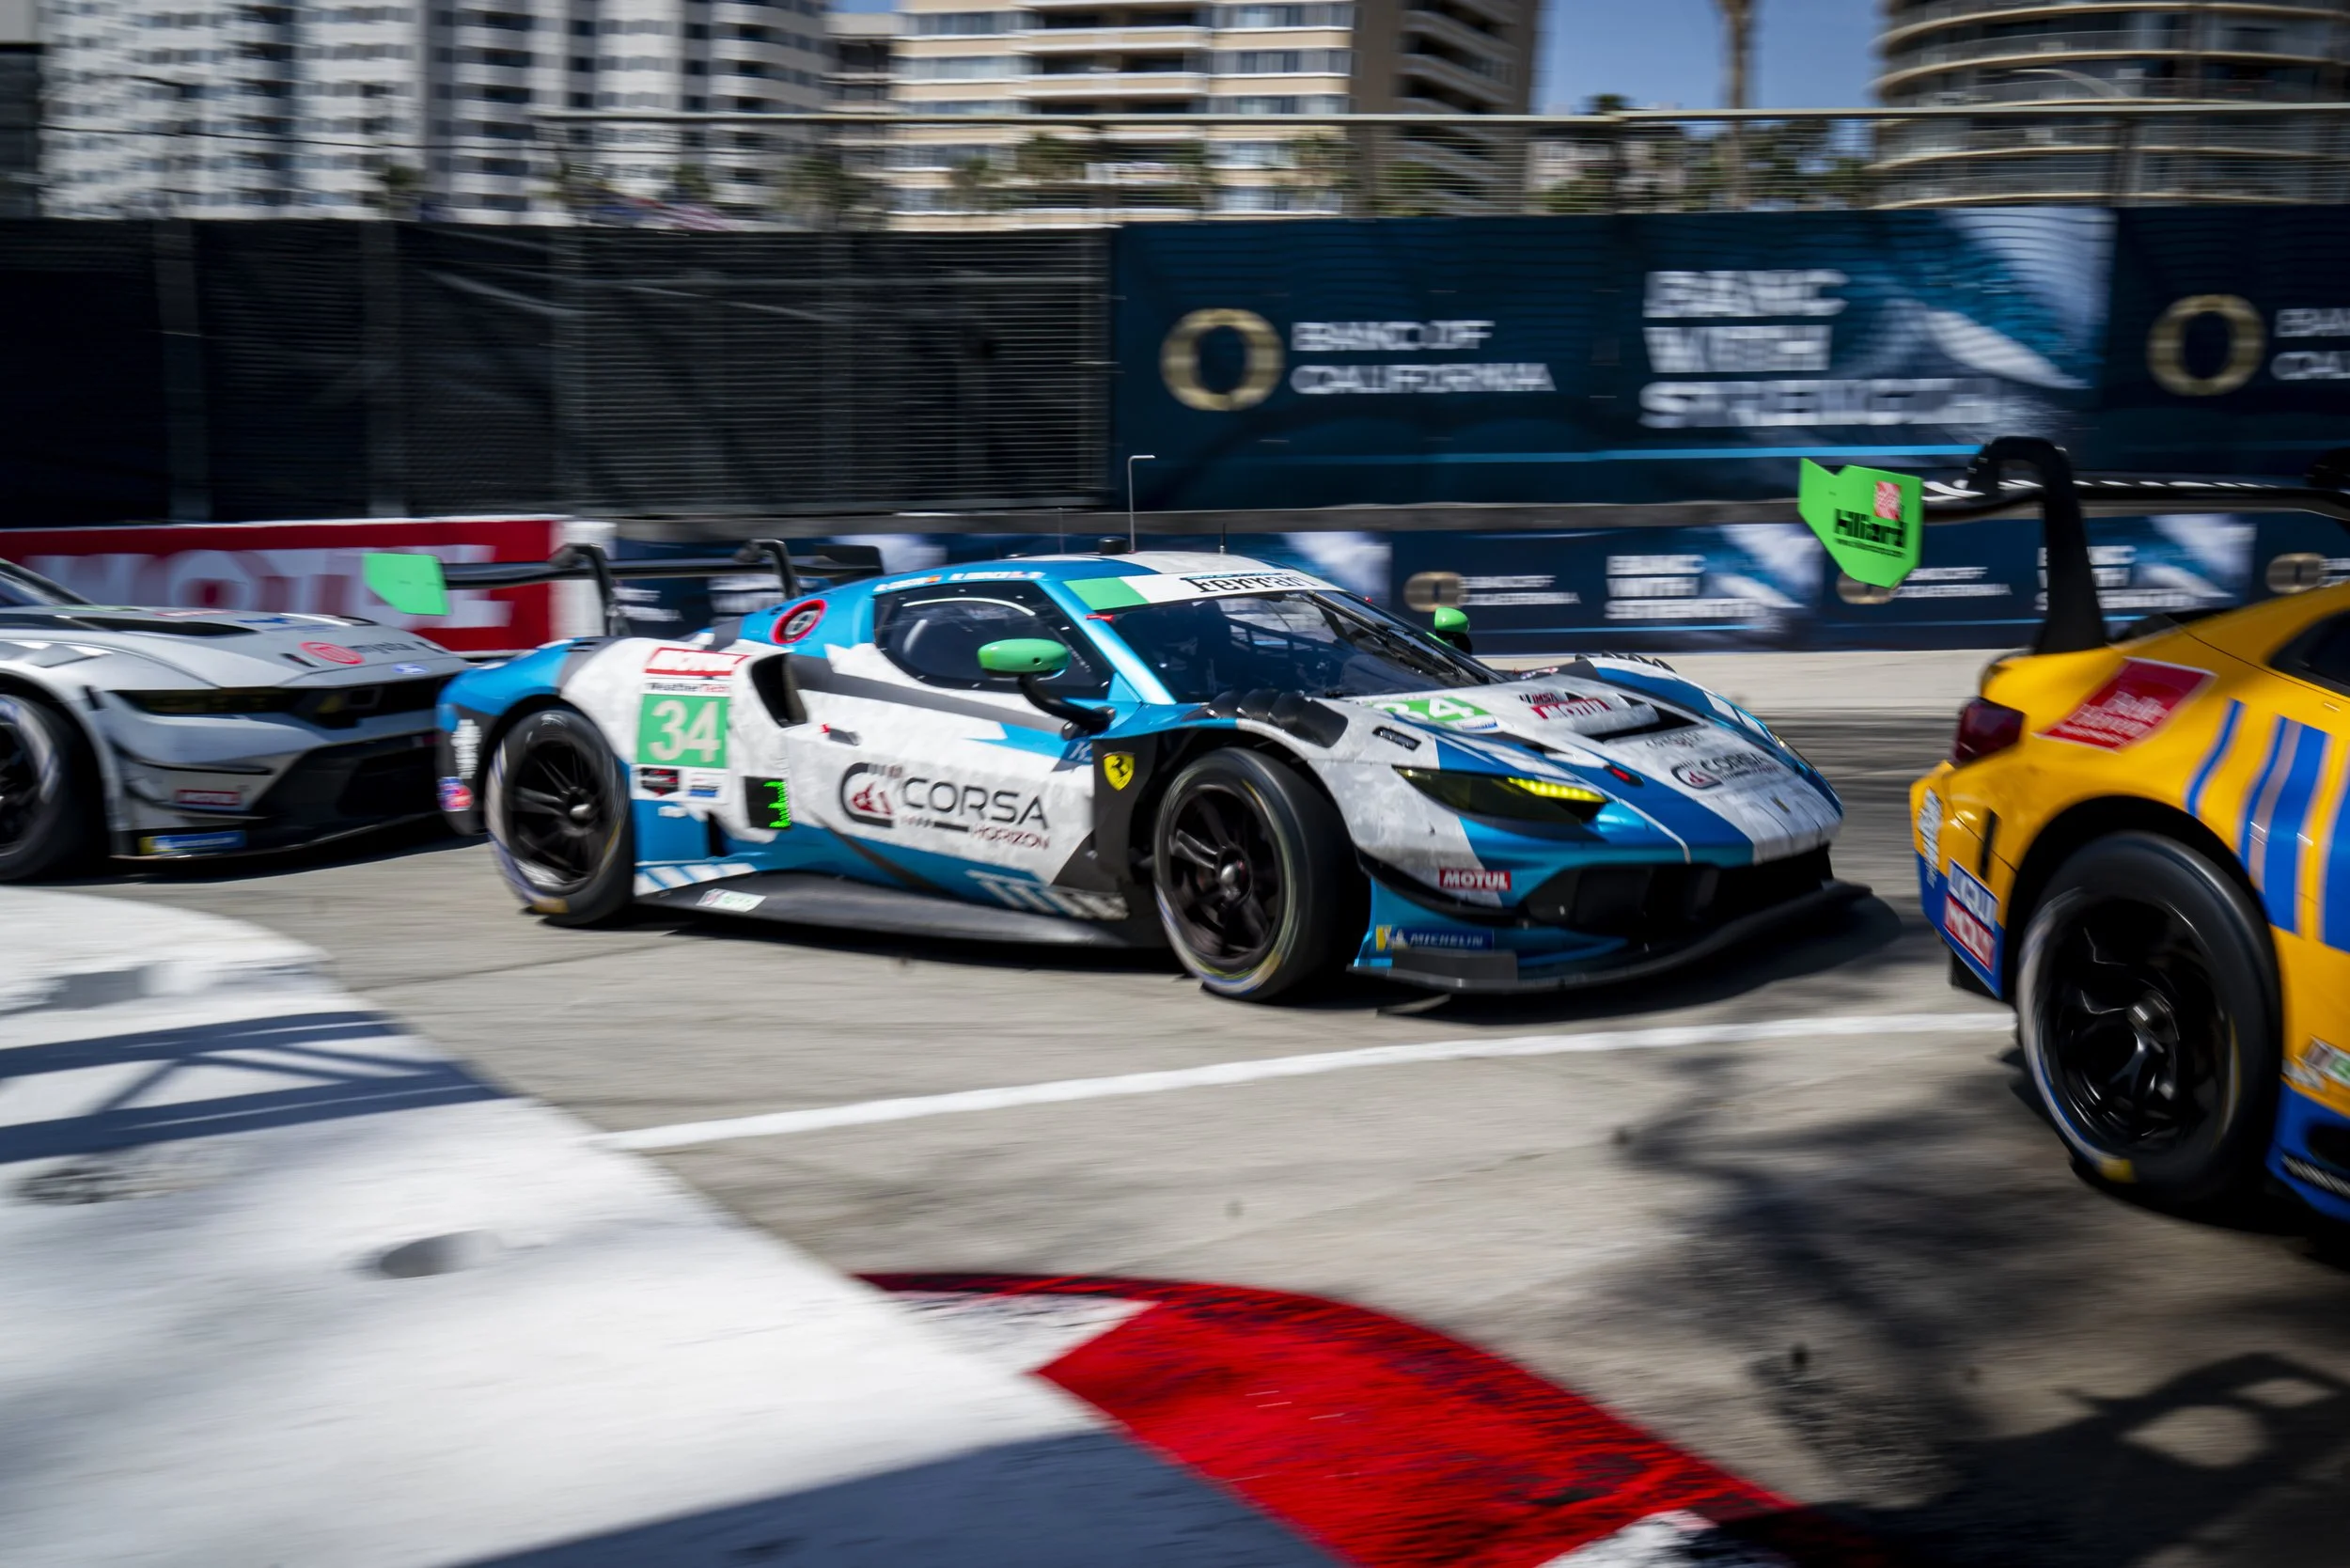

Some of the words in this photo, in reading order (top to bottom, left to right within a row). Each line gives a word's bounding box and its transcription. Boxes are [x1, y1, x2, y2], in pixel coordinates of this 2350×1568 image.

[1289, 363, 1558, 394] CALIFORNIA
[647, 698, 722, 763] 34
[902, 776, 1050, 831] CORSA
[973, 823, 1051, 851] HORIZON
[1442, 870, 1510, 889] MOTUL
[1410, 932, 1484, 948] MICHELIN
